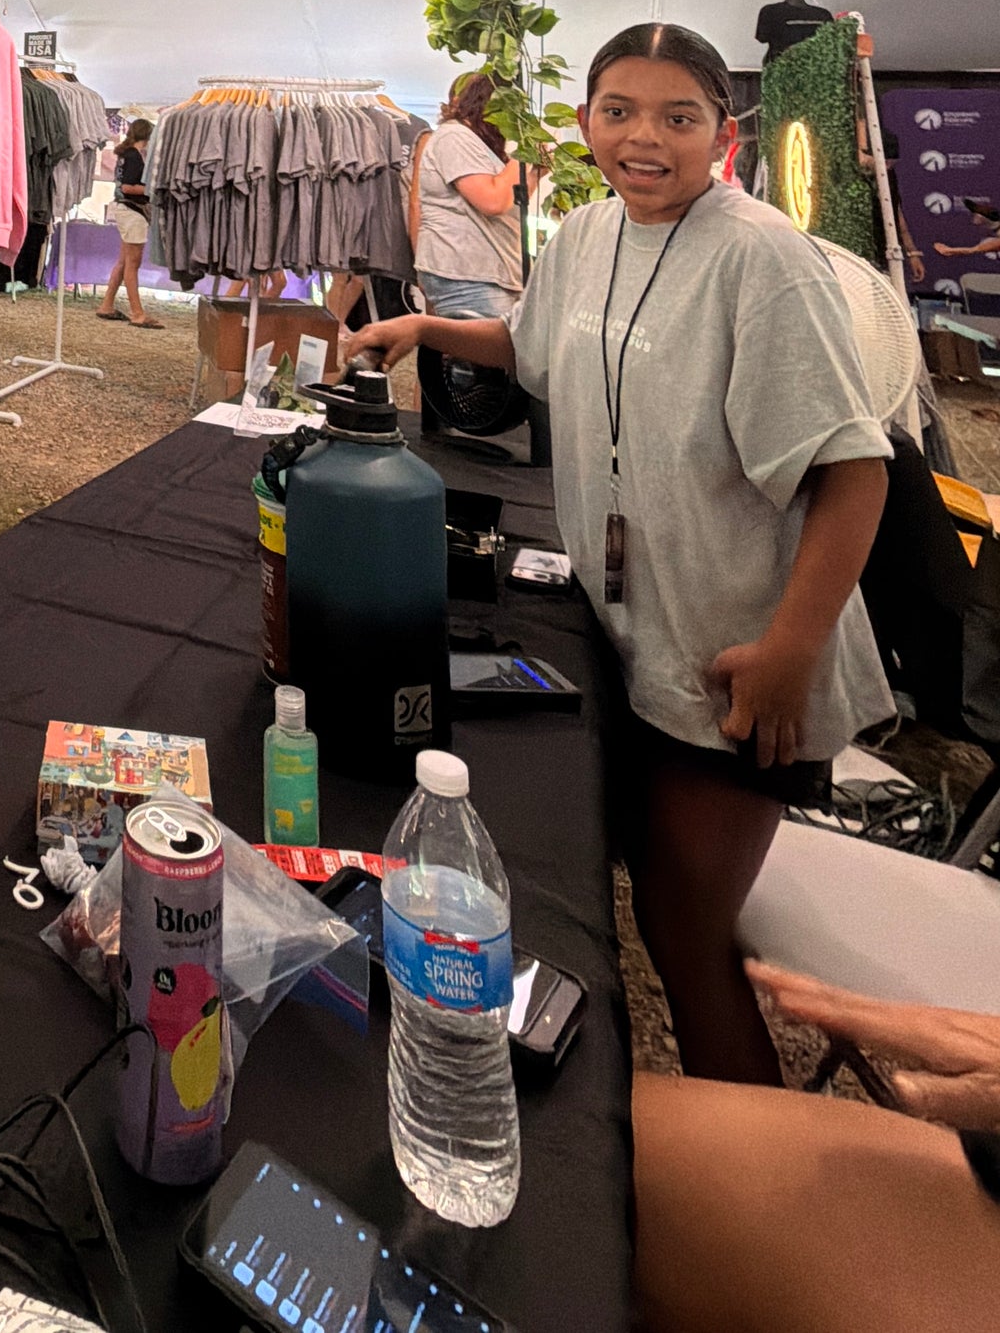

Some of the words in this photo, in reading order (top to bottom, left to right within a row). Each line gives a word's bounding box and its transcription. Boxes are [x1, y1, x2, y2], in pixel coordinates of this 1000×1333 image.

[28, 45, 52, 56] USA
[164, 865, 207, 875] RASPBERRY
[431, 953, 475, 971] NATURAL
[424, 960, 484, 989] SPRING
[435, 982, 476, 1001] WATER
